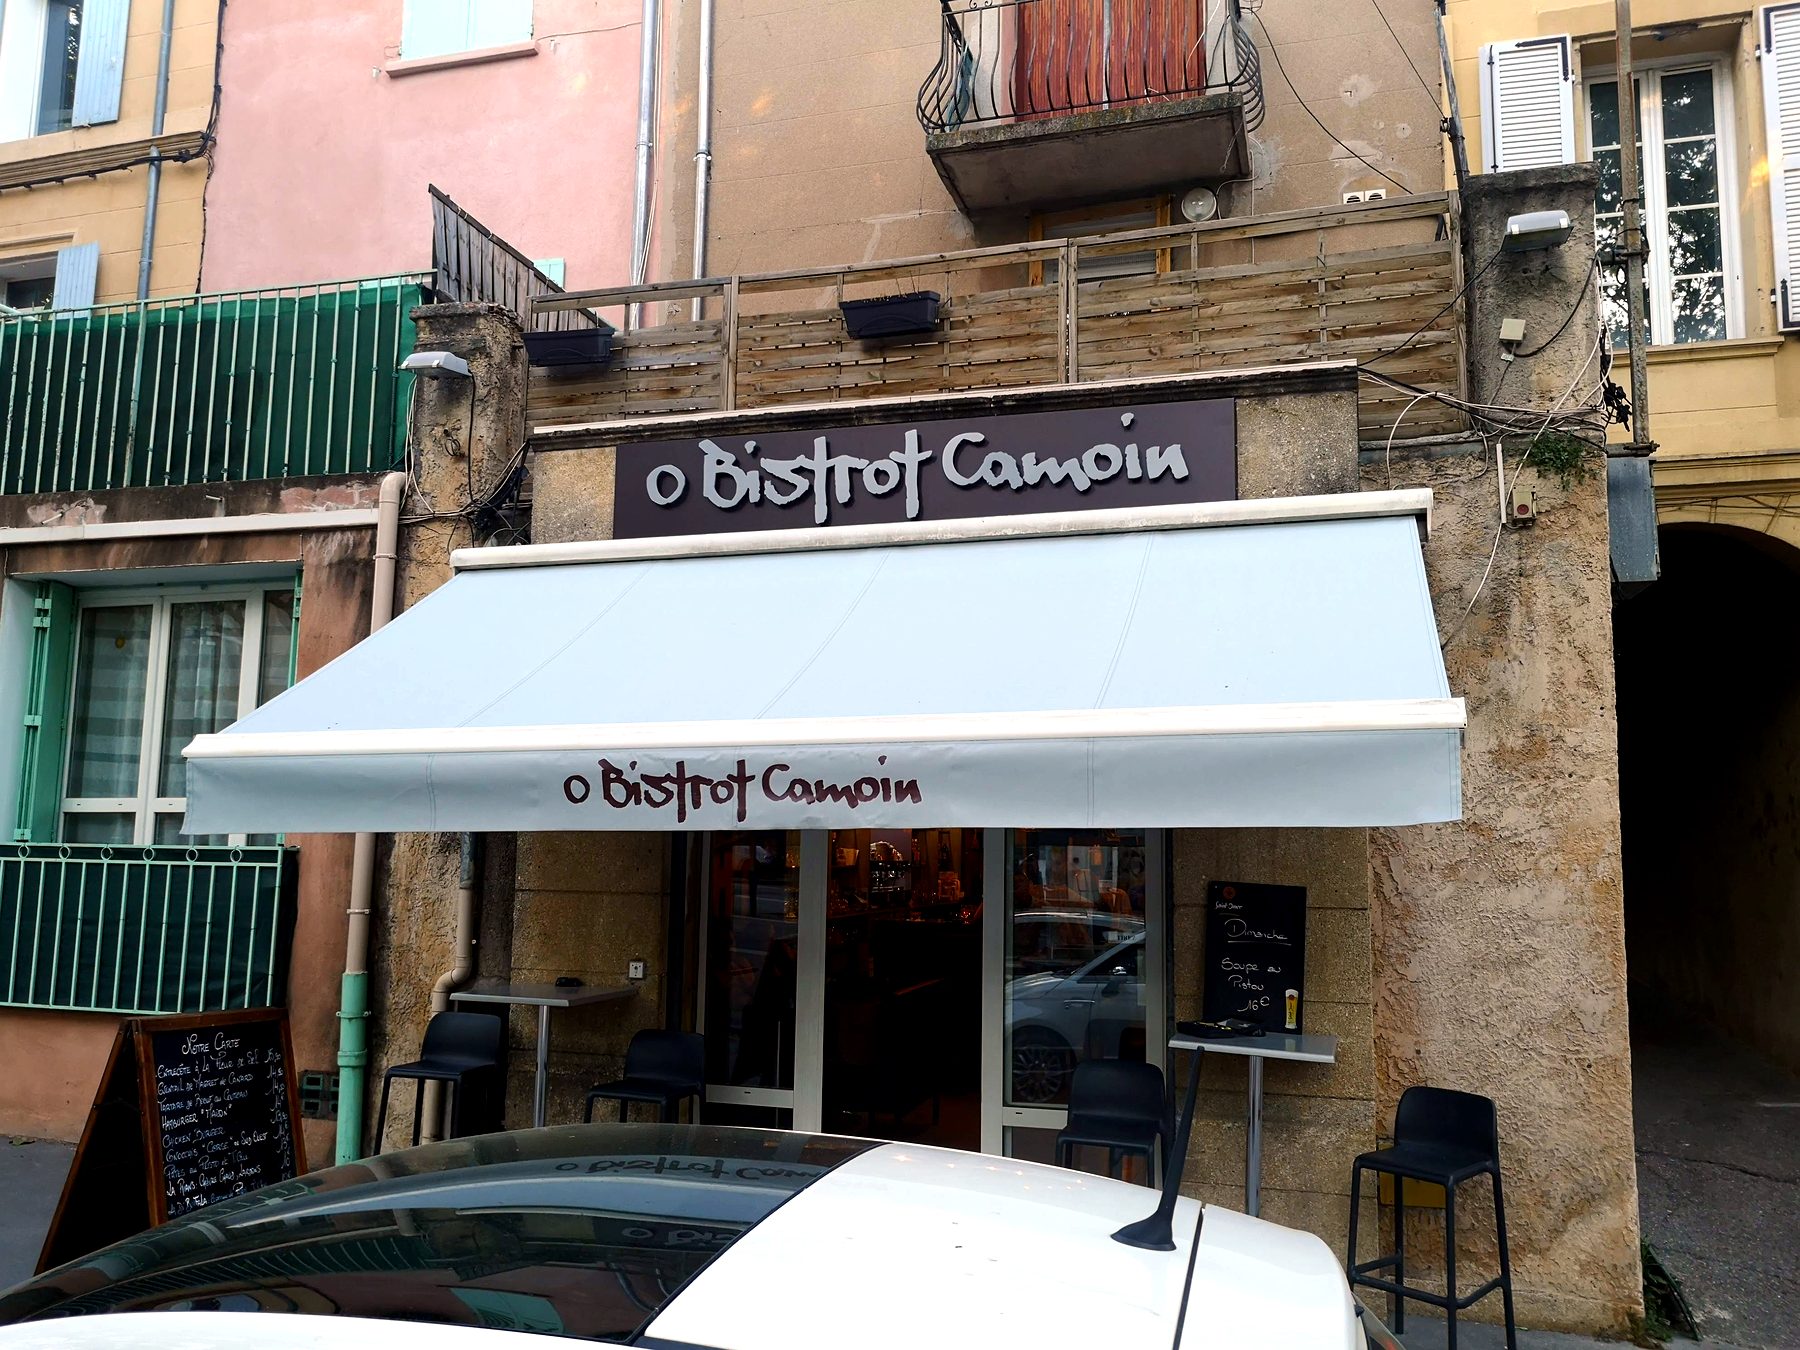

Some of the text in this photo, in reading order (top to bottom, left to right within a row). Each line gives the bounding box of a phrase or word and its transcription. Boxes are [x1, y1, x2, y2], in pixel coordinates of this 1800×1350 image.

[699, 429, 932, 524] Bistrot
[942, 413, 1189, 492] Camoin
[600, 758, 755, 823] Bistrot
[762, 755, 922, 809] Camoin
[1224, 918, 1288, 940] Dimanche
[1221, 957, 1281, 975] Soupe au
[1228, 974, 1264, 991] Pistou
